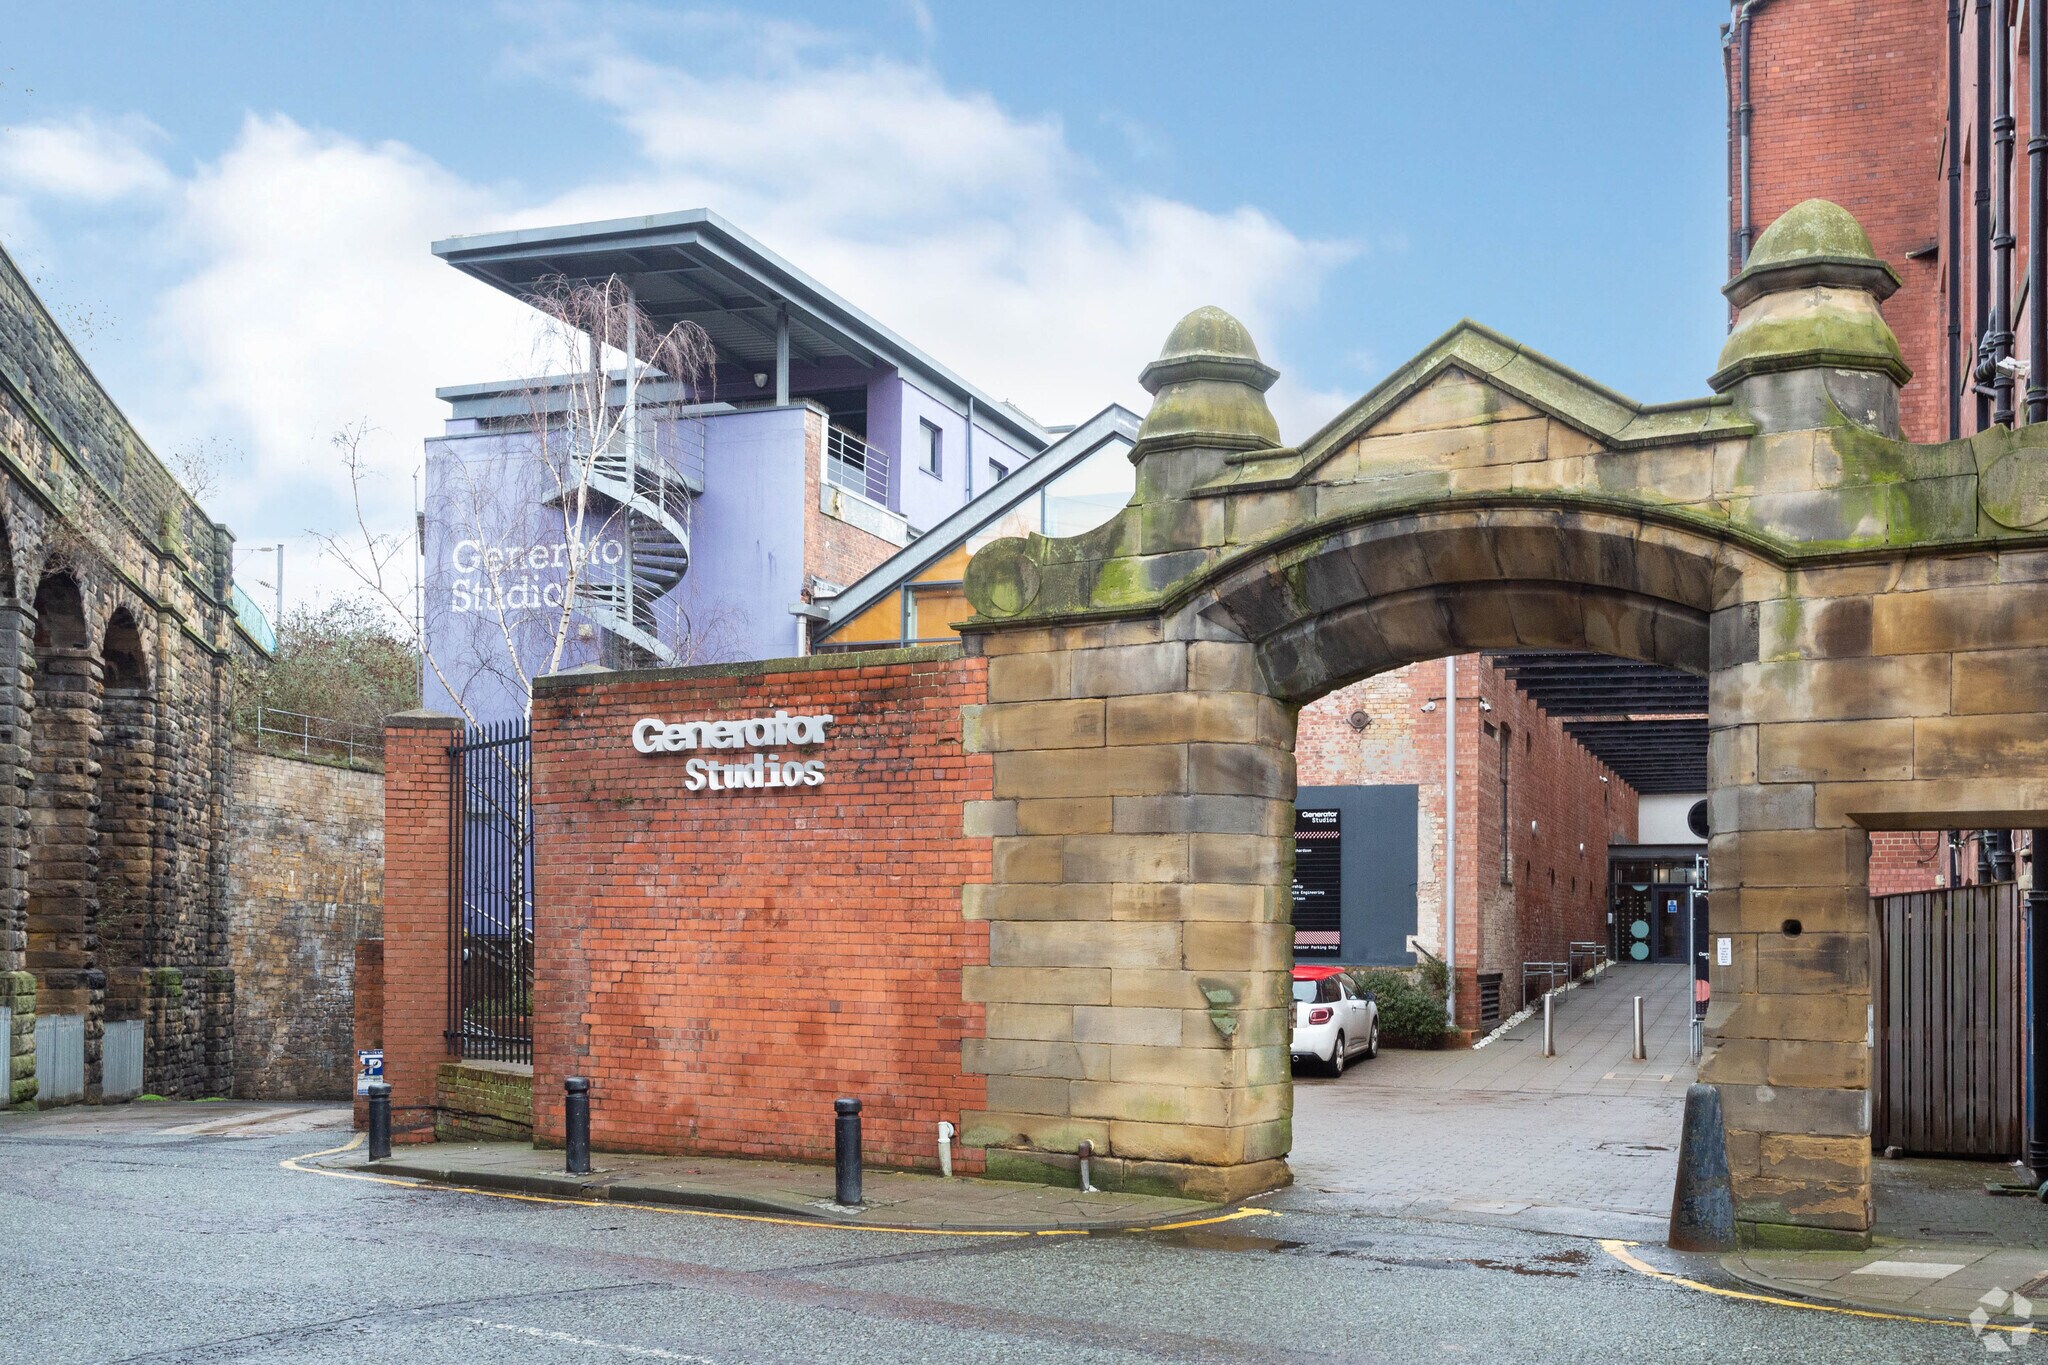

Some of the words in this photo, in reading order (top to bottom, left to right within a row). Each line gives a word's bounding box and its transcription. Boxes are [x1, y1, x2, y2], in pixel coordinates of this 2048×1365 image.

[451, 575, 567, 613] Studio
[632, 710, 834, 754] Generator
[685, 753, 826, 792] Studios
